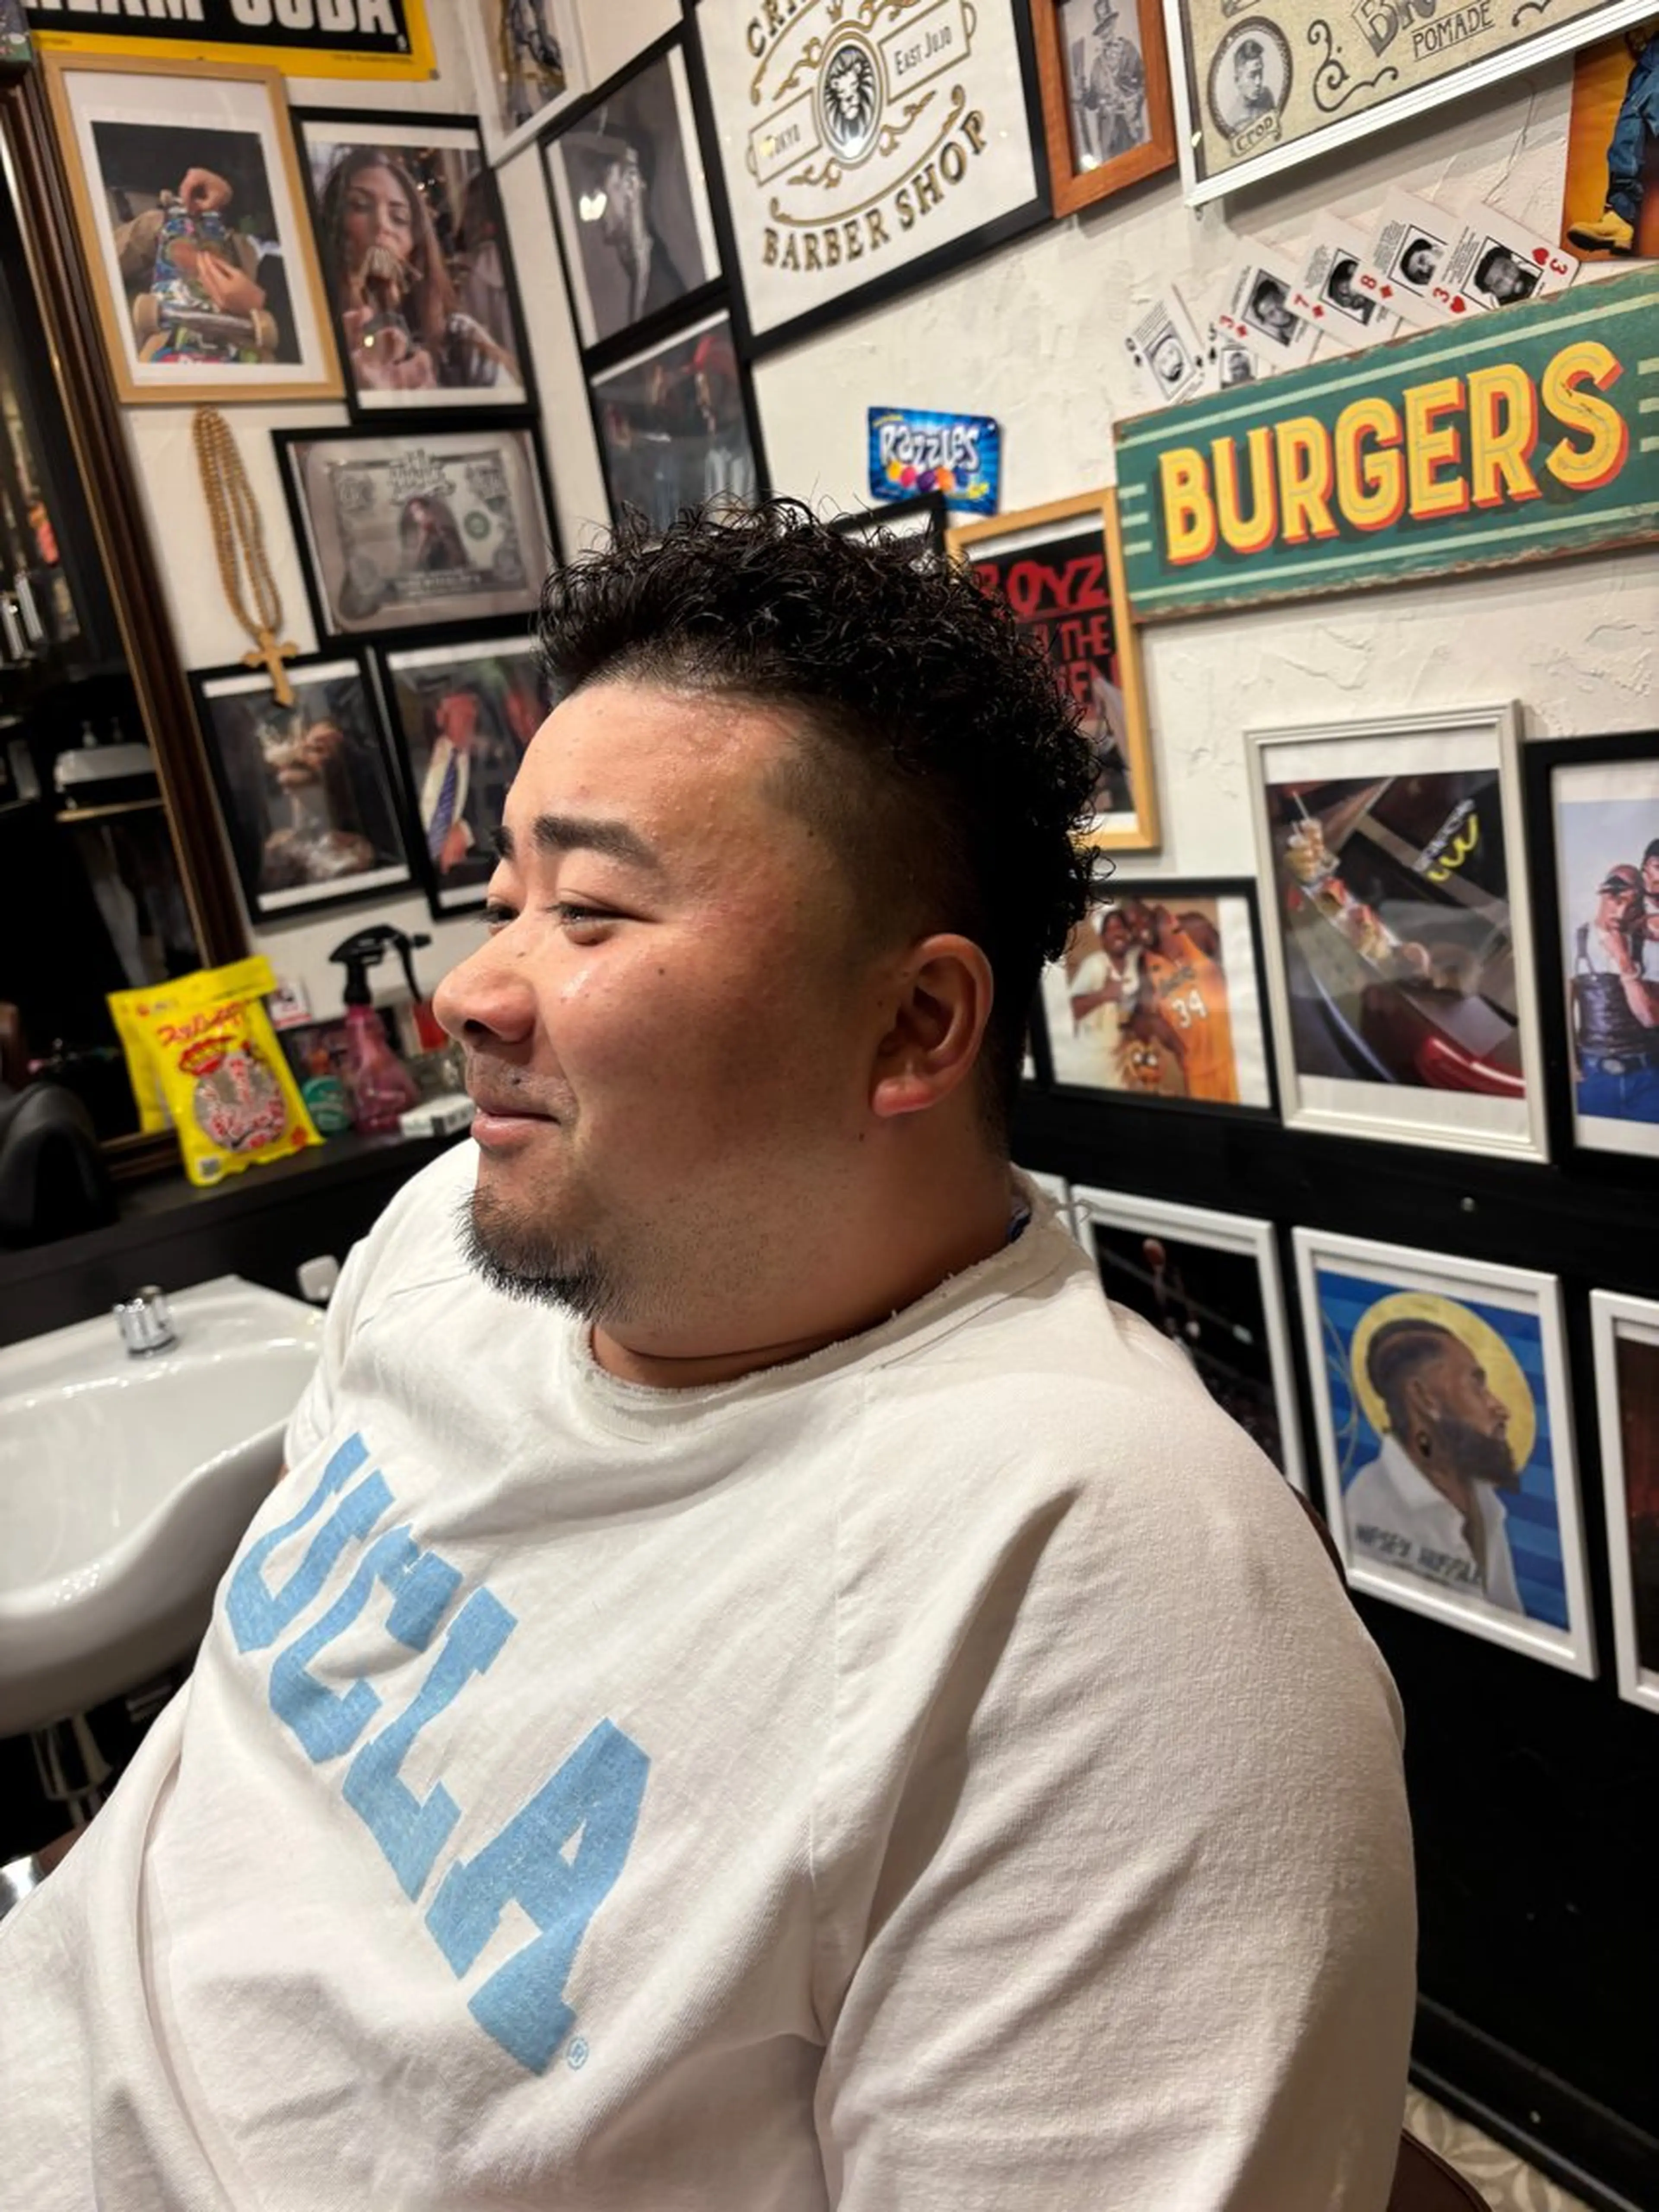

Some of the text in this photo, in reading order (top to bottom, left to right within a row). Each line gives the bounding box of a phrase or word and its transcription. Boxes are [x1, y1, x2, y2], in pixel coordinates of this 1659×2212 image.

[1413, 2, 1493, 58] POMADE
[762, 110, 987, 271] BARBER SHOP
[1360, 274, 1377, 290] 8
[1158, 341, 1630, 566] BURGERS
[972, 553, 1111, 617] BOYZ
[1061, 616, 1111, 660] THE
[1172, 989, 1207, 1028] 34
[225, 1431, 652, 2077] UCLA
